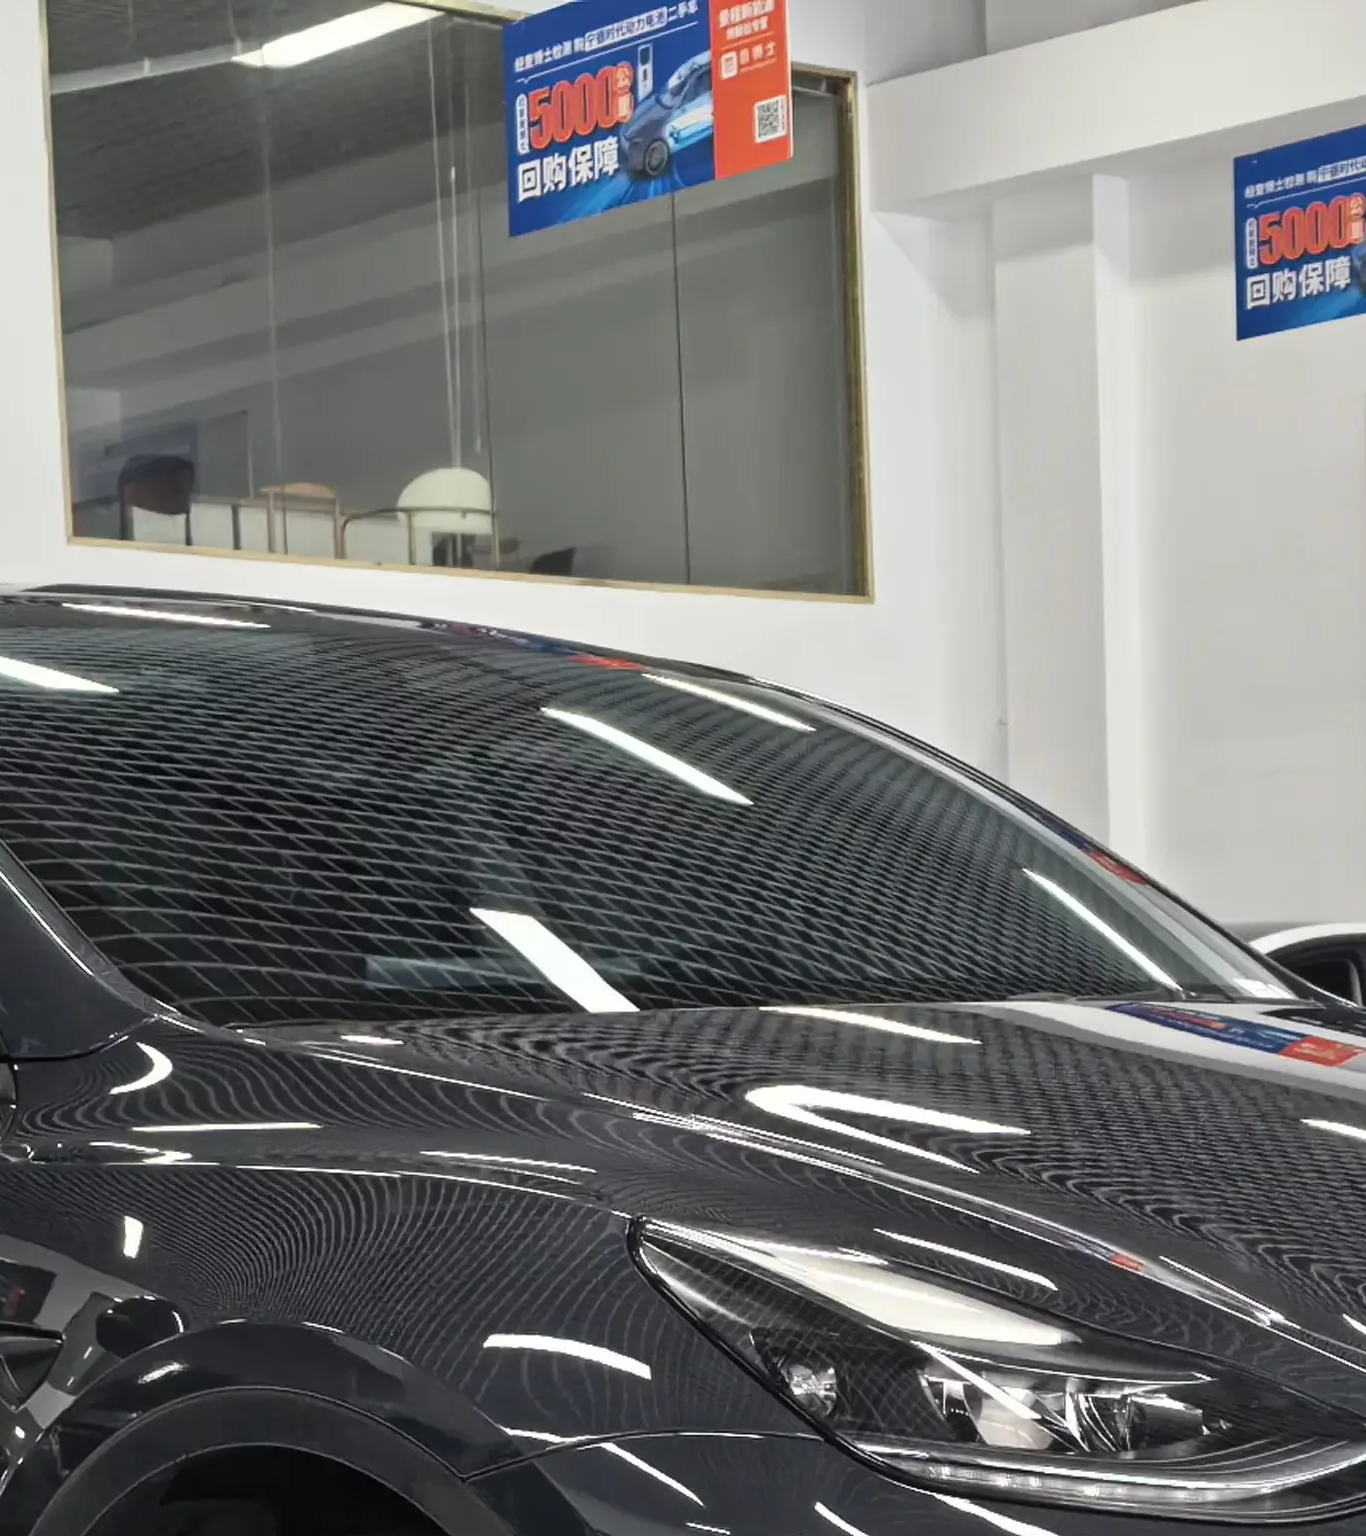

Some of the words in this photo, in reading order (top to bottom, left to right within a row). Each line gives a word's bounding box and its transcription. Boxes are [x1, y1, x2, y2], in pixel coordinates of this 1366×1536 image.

[517, 136, 620, 204] 回购保障
[1245, 256, 1352, 310] 回购保障
